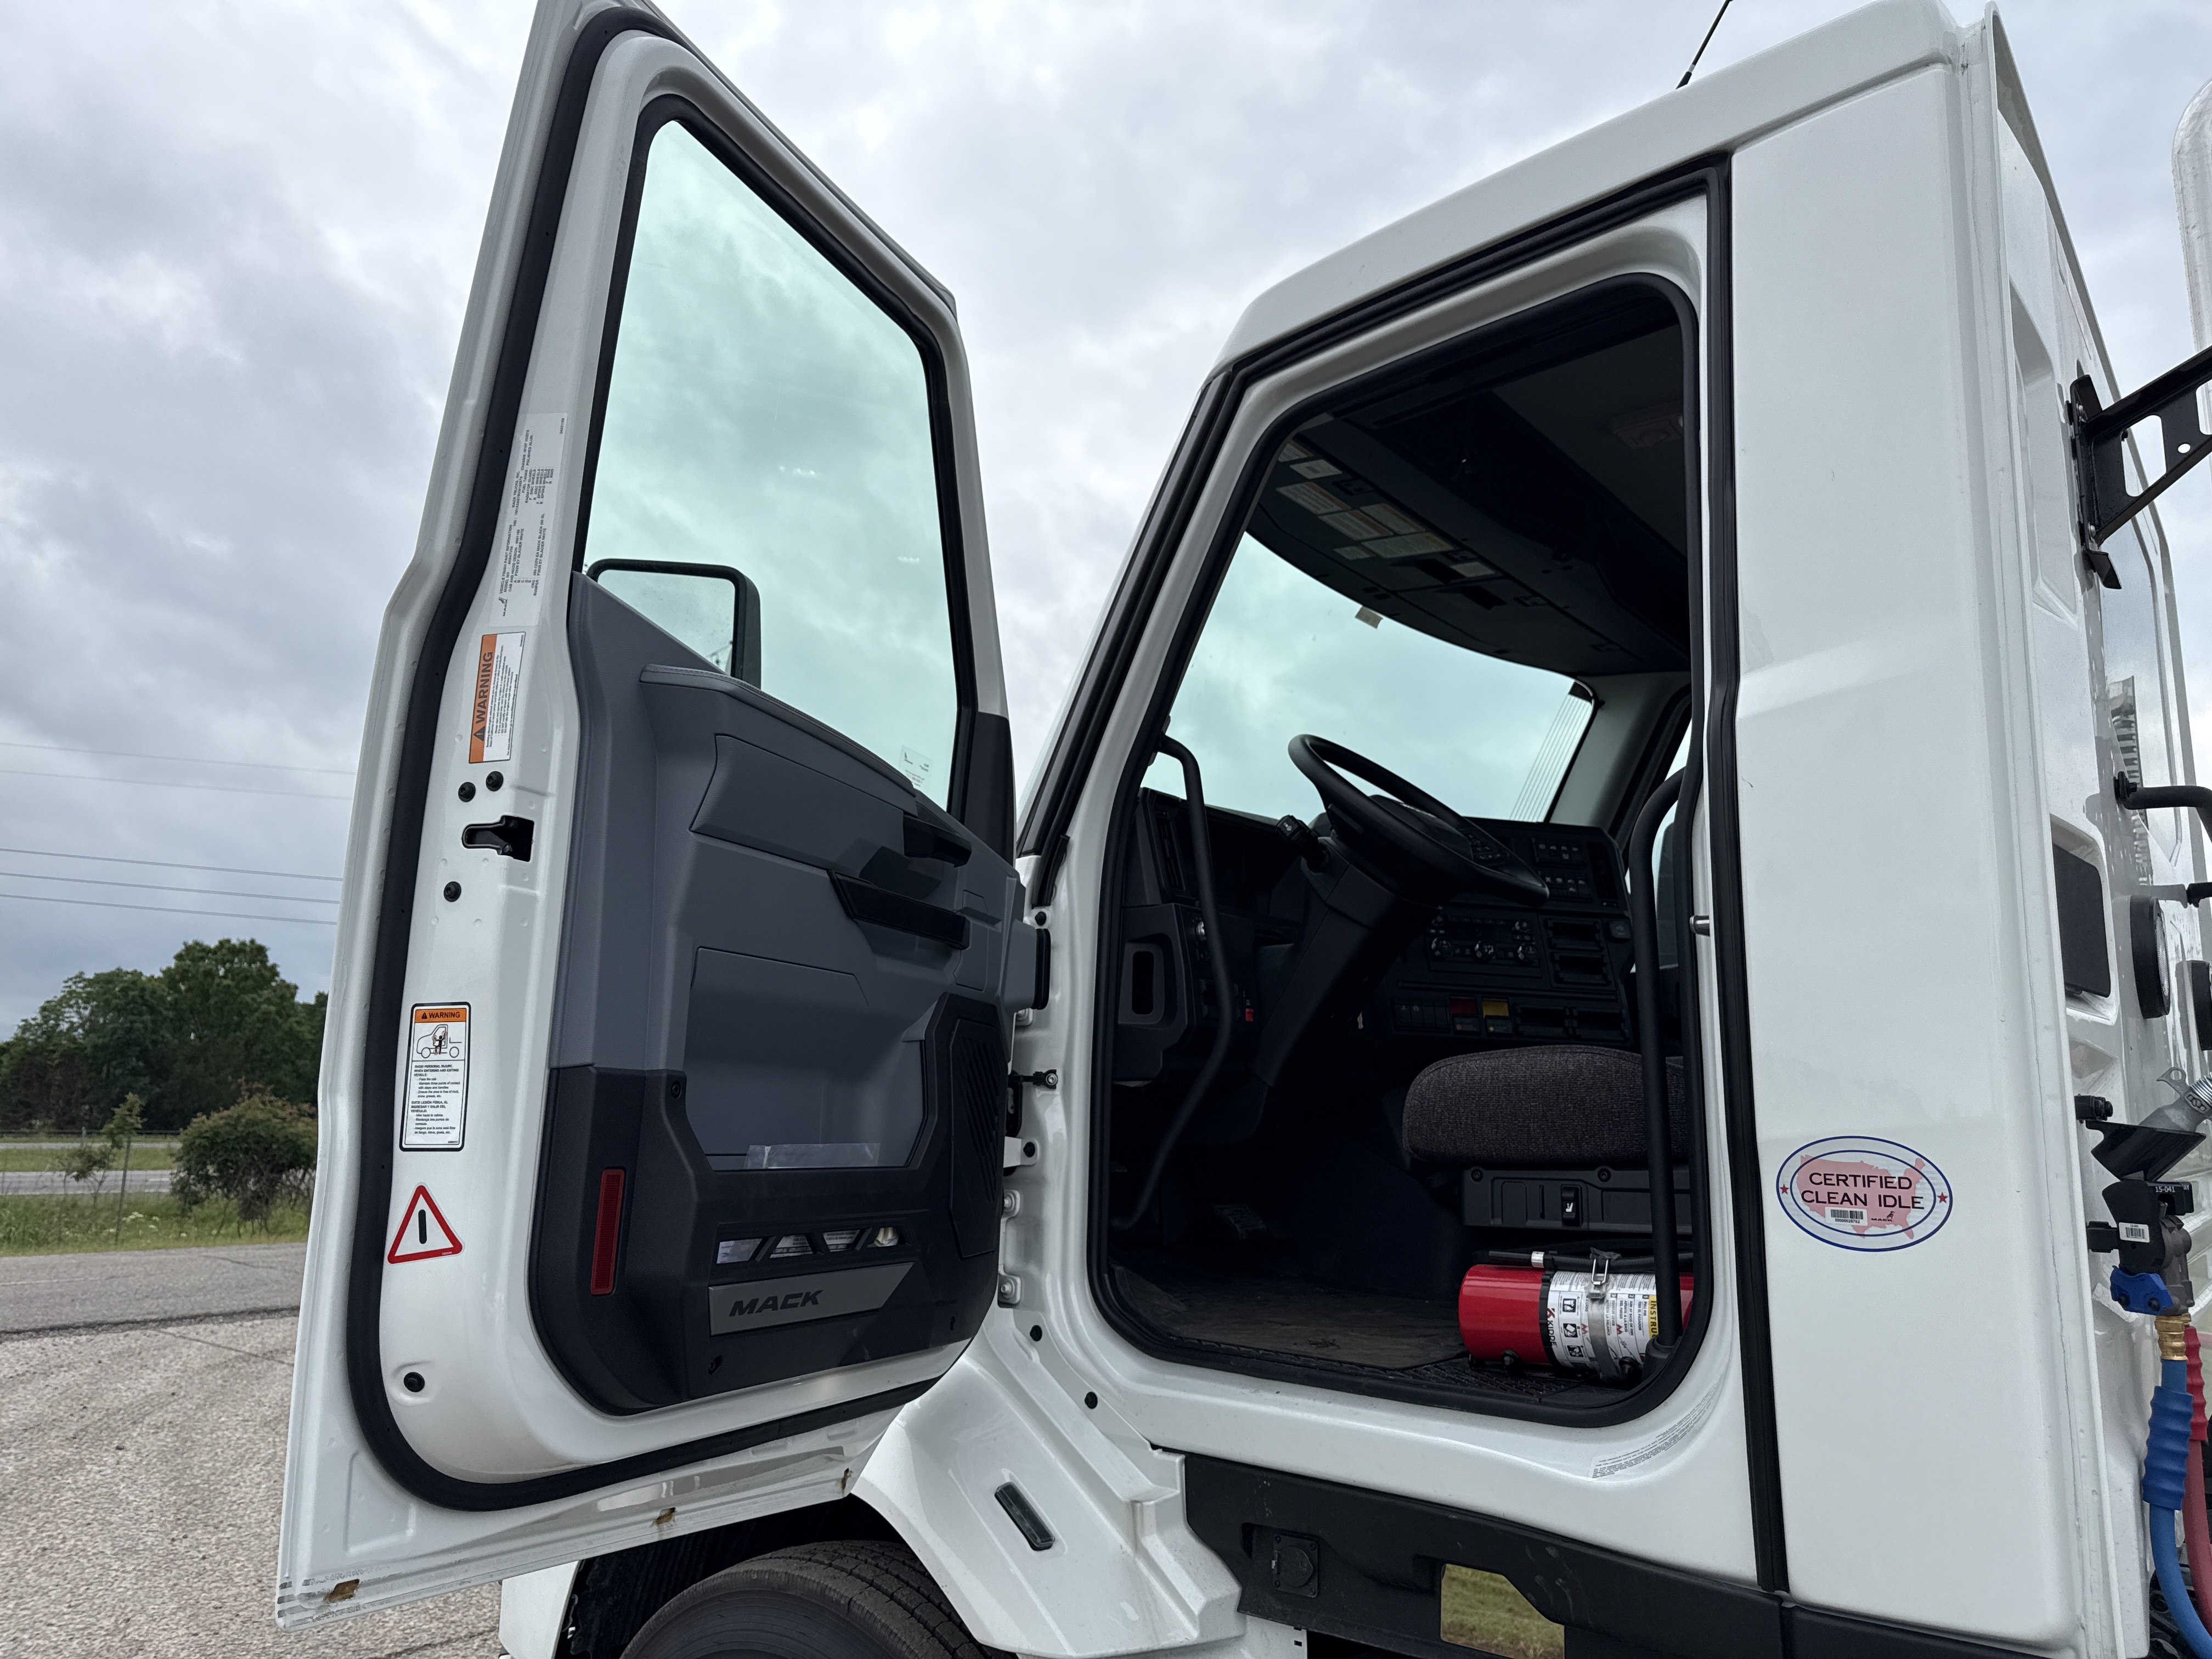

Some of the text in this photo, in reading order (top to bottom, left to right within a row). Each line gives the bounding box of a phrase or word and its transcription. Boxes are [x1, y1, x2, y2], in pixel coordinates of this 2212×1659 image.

[476, 652, 493, 724] WARNING
[1809, 1172, 1912, 1190] CERTIFIED
[1802, 1190, 1925, 1210] CLEAN IDLE
[729, 1289, 824, 1317] MACK
